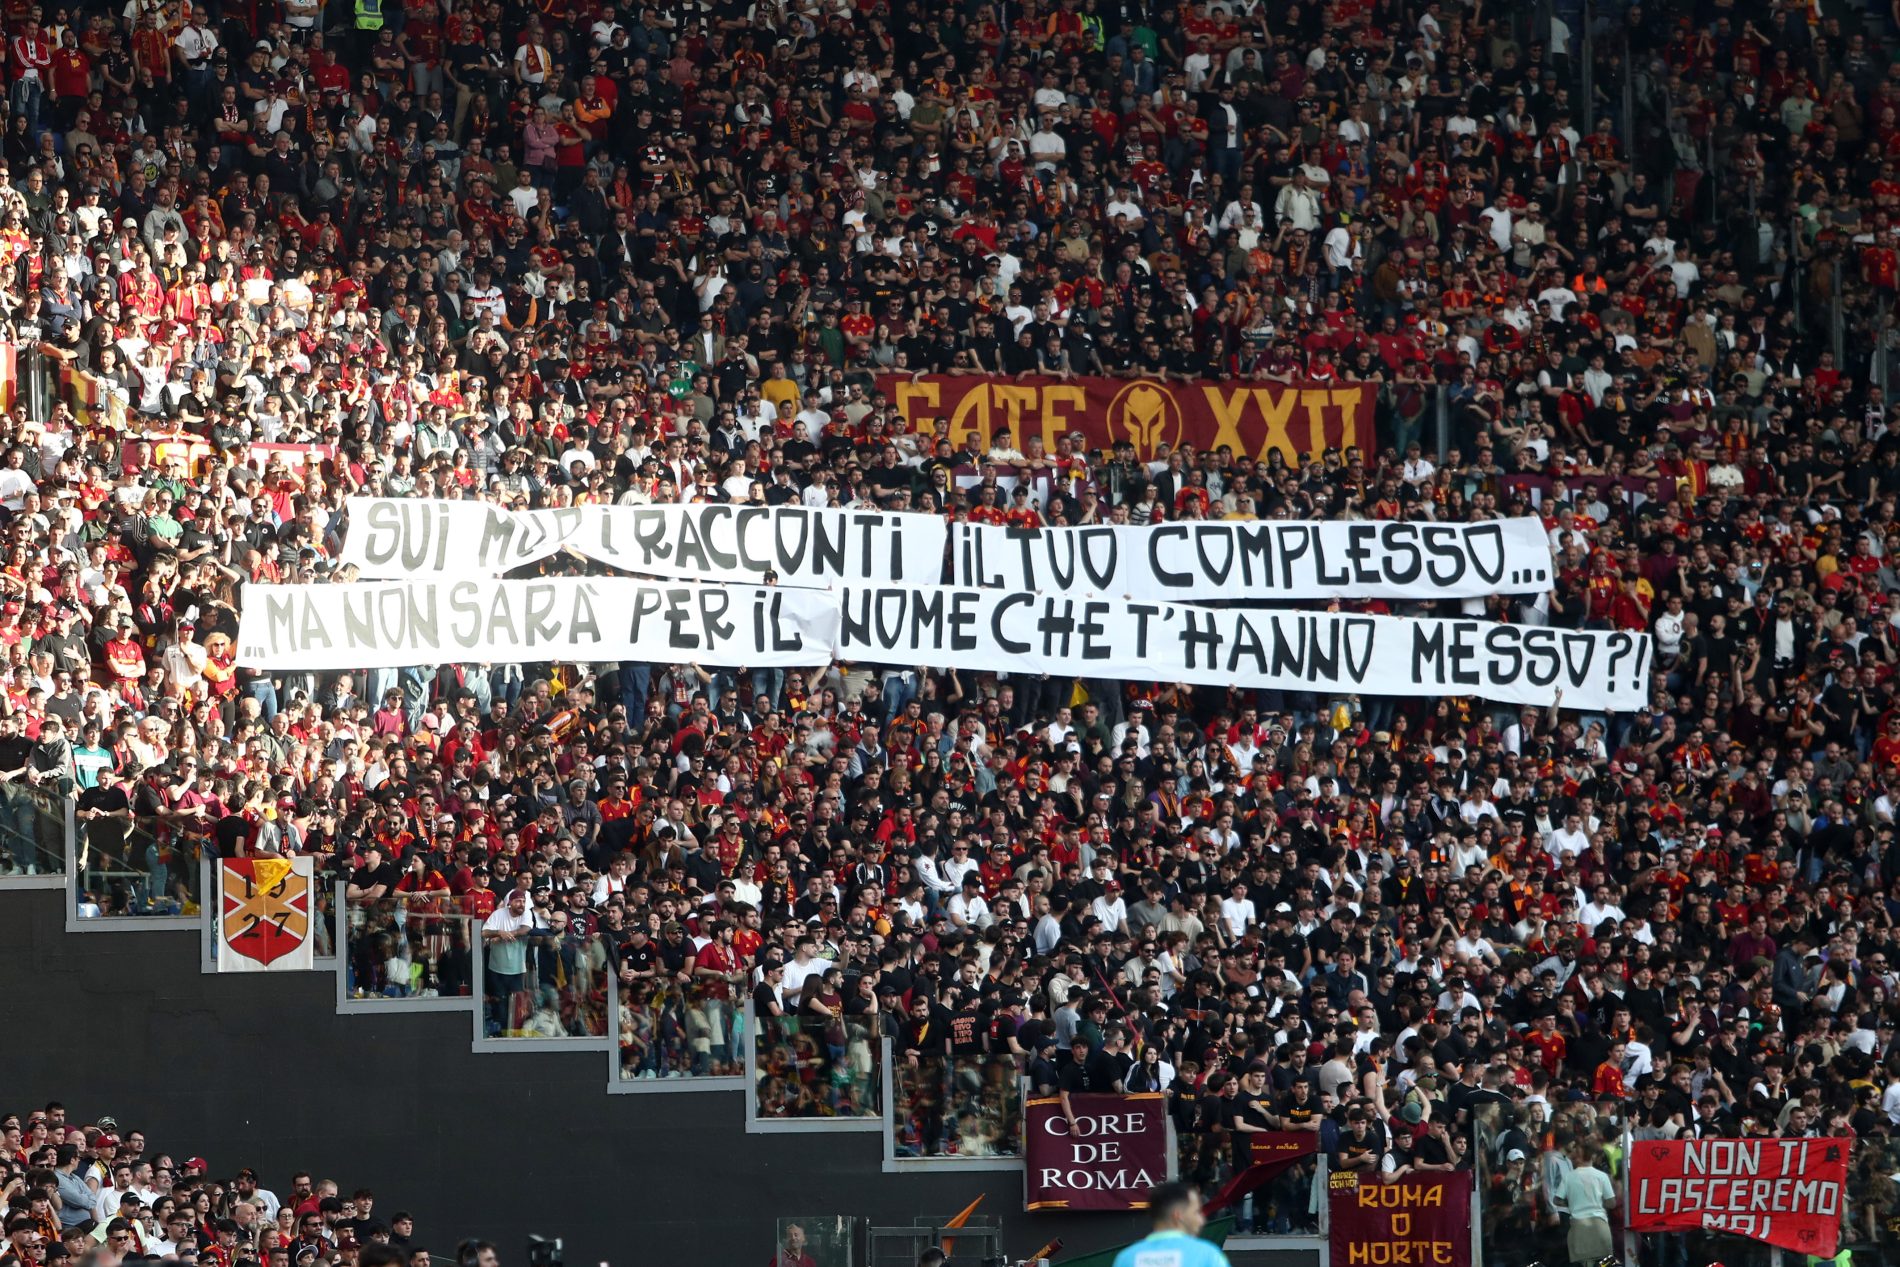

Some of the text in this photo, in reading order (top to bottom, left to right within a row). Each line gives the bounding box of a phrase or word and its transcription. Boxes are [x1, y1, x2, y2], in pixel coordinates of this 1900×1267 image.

[896, 381, 1362, 469] GATE XXII
[1005, 526, 1118, 592] TUO
[343, 584, 440, 650] NON
[630, 586, 735, 651] PER
[840, 586, 981, 650] NOME
[990, 592, 1112, 660] CHE
[243, 911, 292, 938] 27
[1044, 1112, 1147, 1137] CORE
[1070, 1141, 1122, 1164] DE
[1682, 1140, 1809, 1176] NON TI
[1039, 1168, 1157, 1190] ROMA
[1358, 1184, 1443, 1208] ROMA
[1638, 1178, 1840, 1216] LASCEREMO
[1391, 1212, 1411, 1237] O
[1348, 1241, 1453, 1265] MORTE
